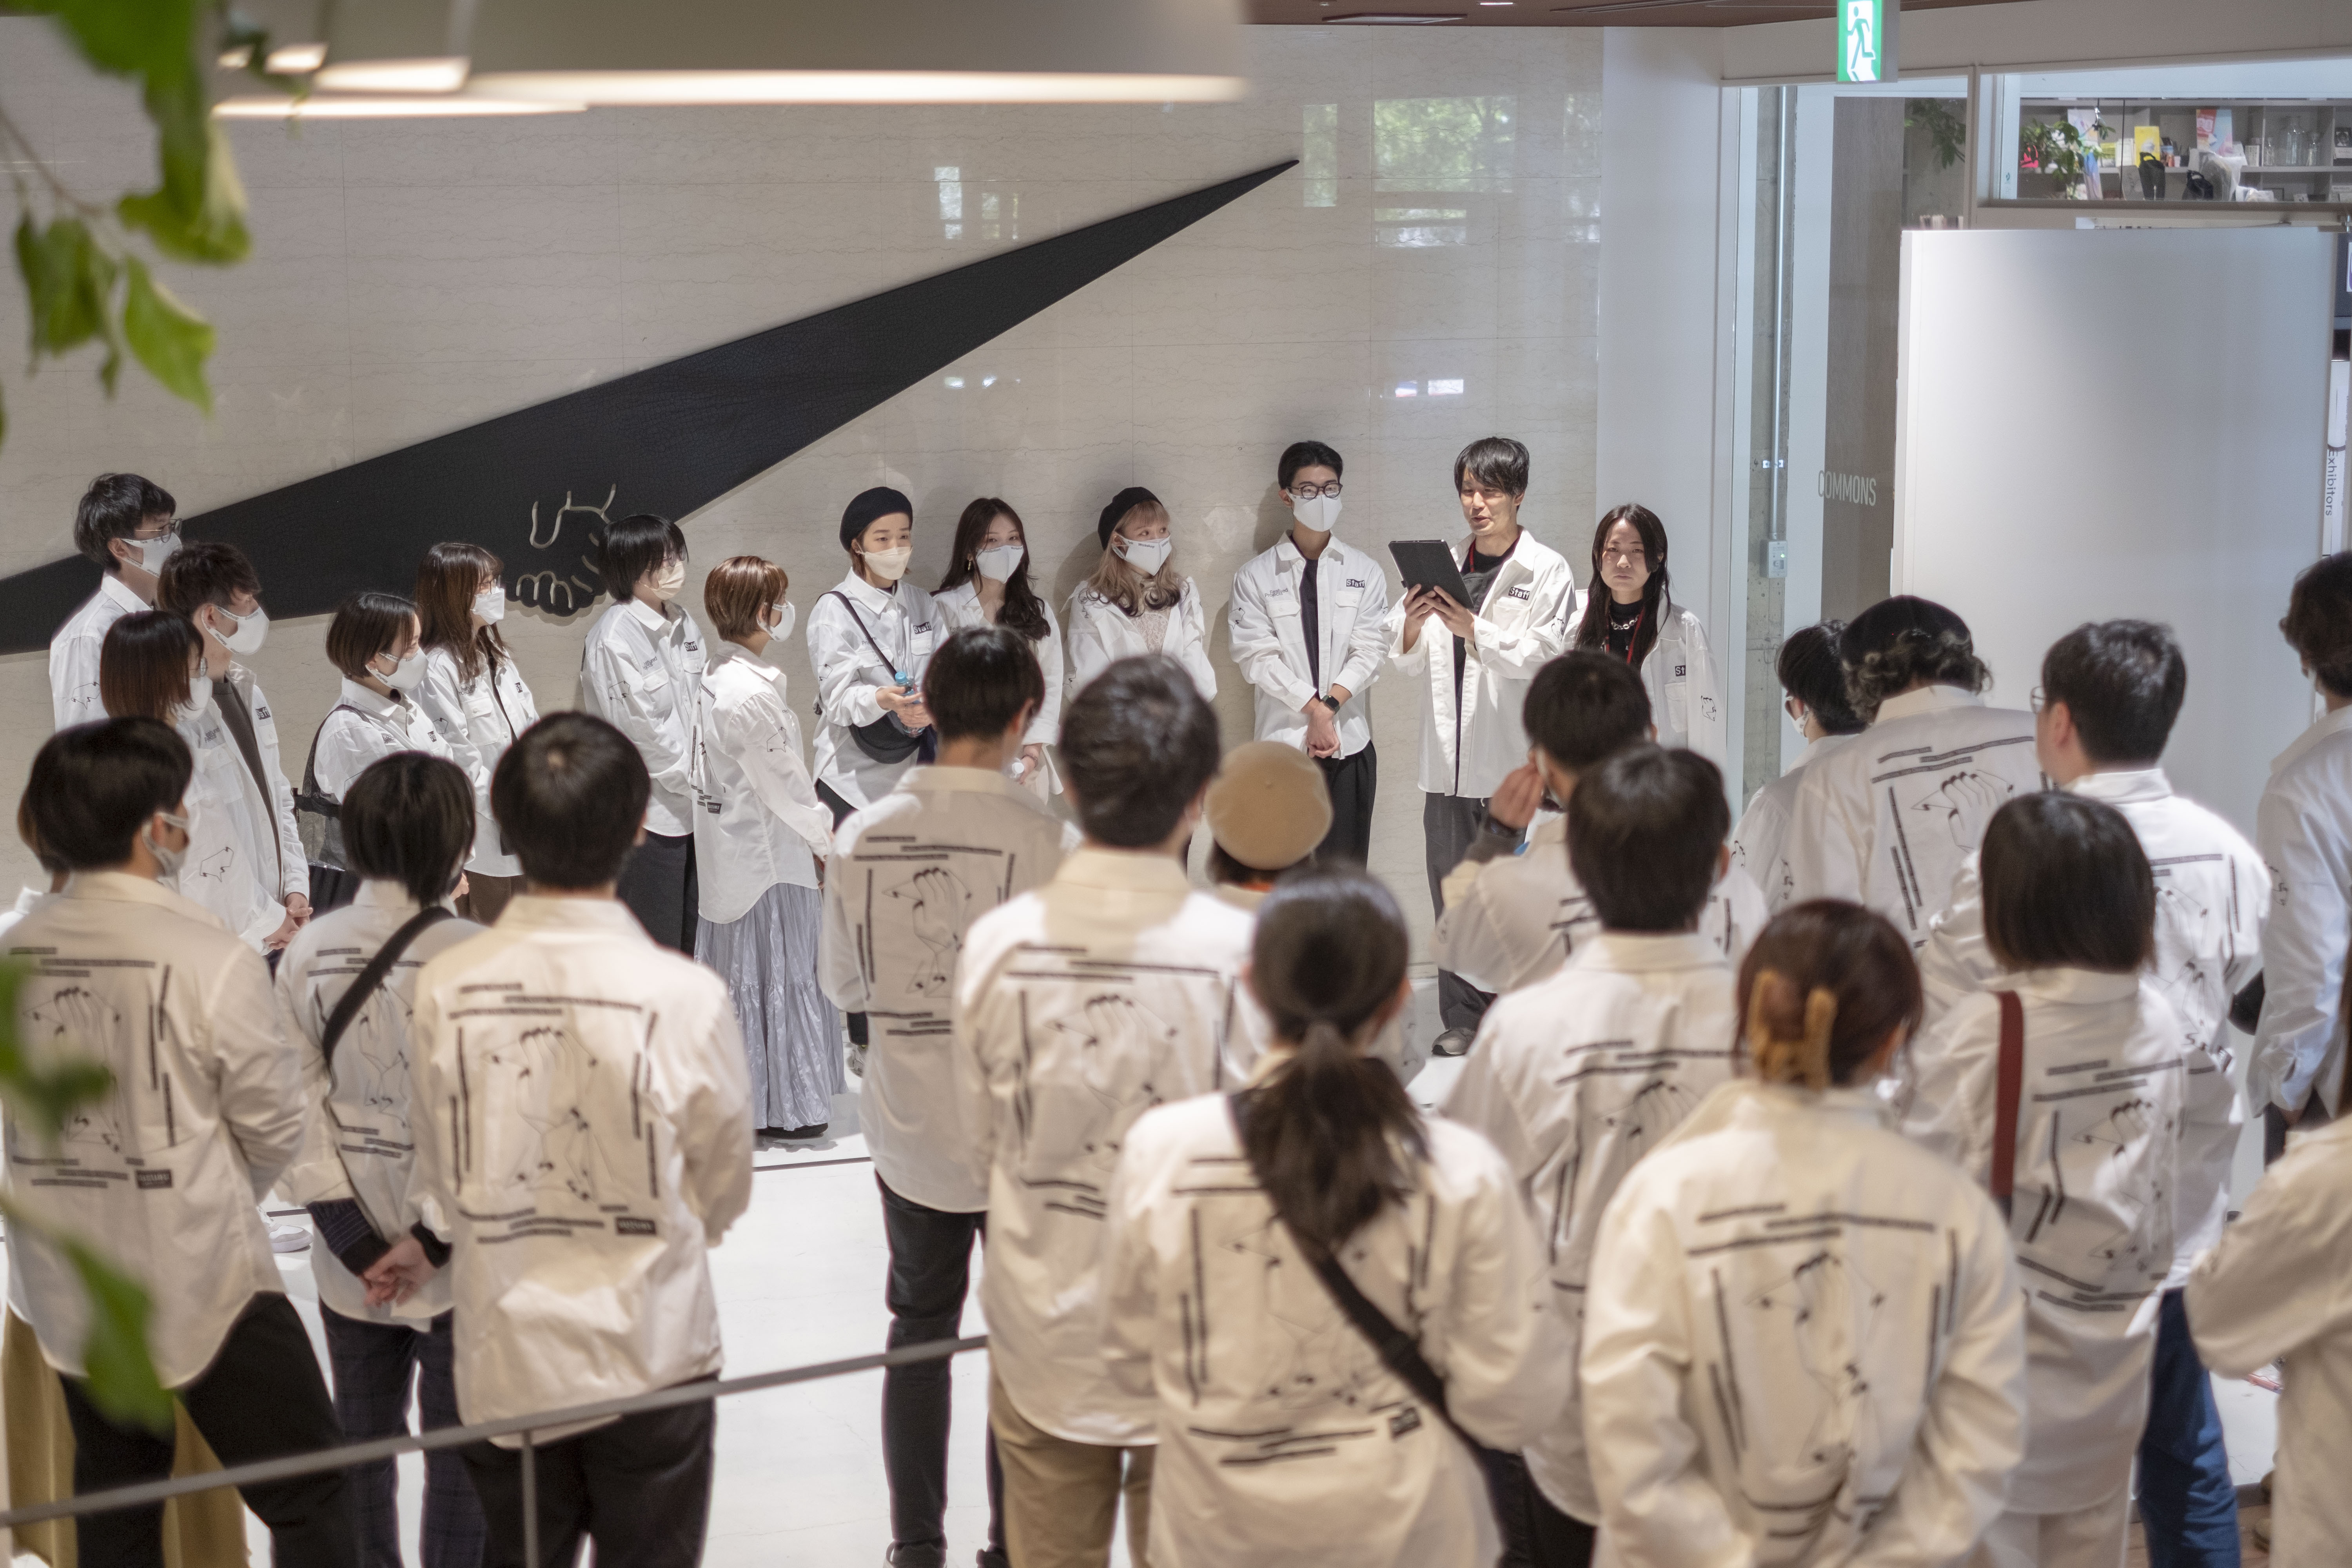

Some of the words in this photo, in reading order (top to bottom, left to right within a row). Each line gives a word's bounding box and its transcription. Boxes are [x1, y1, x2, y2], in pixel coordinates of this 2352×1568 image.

[1818, 470, 1876, 506] COMMONS
[2325, 450, 2338, 516] Exhibitors
[1347, 579, 1365, 588] Staff
[1509, 587, 1530, 600] Staff
[913, 622, 932, 634] Staff
